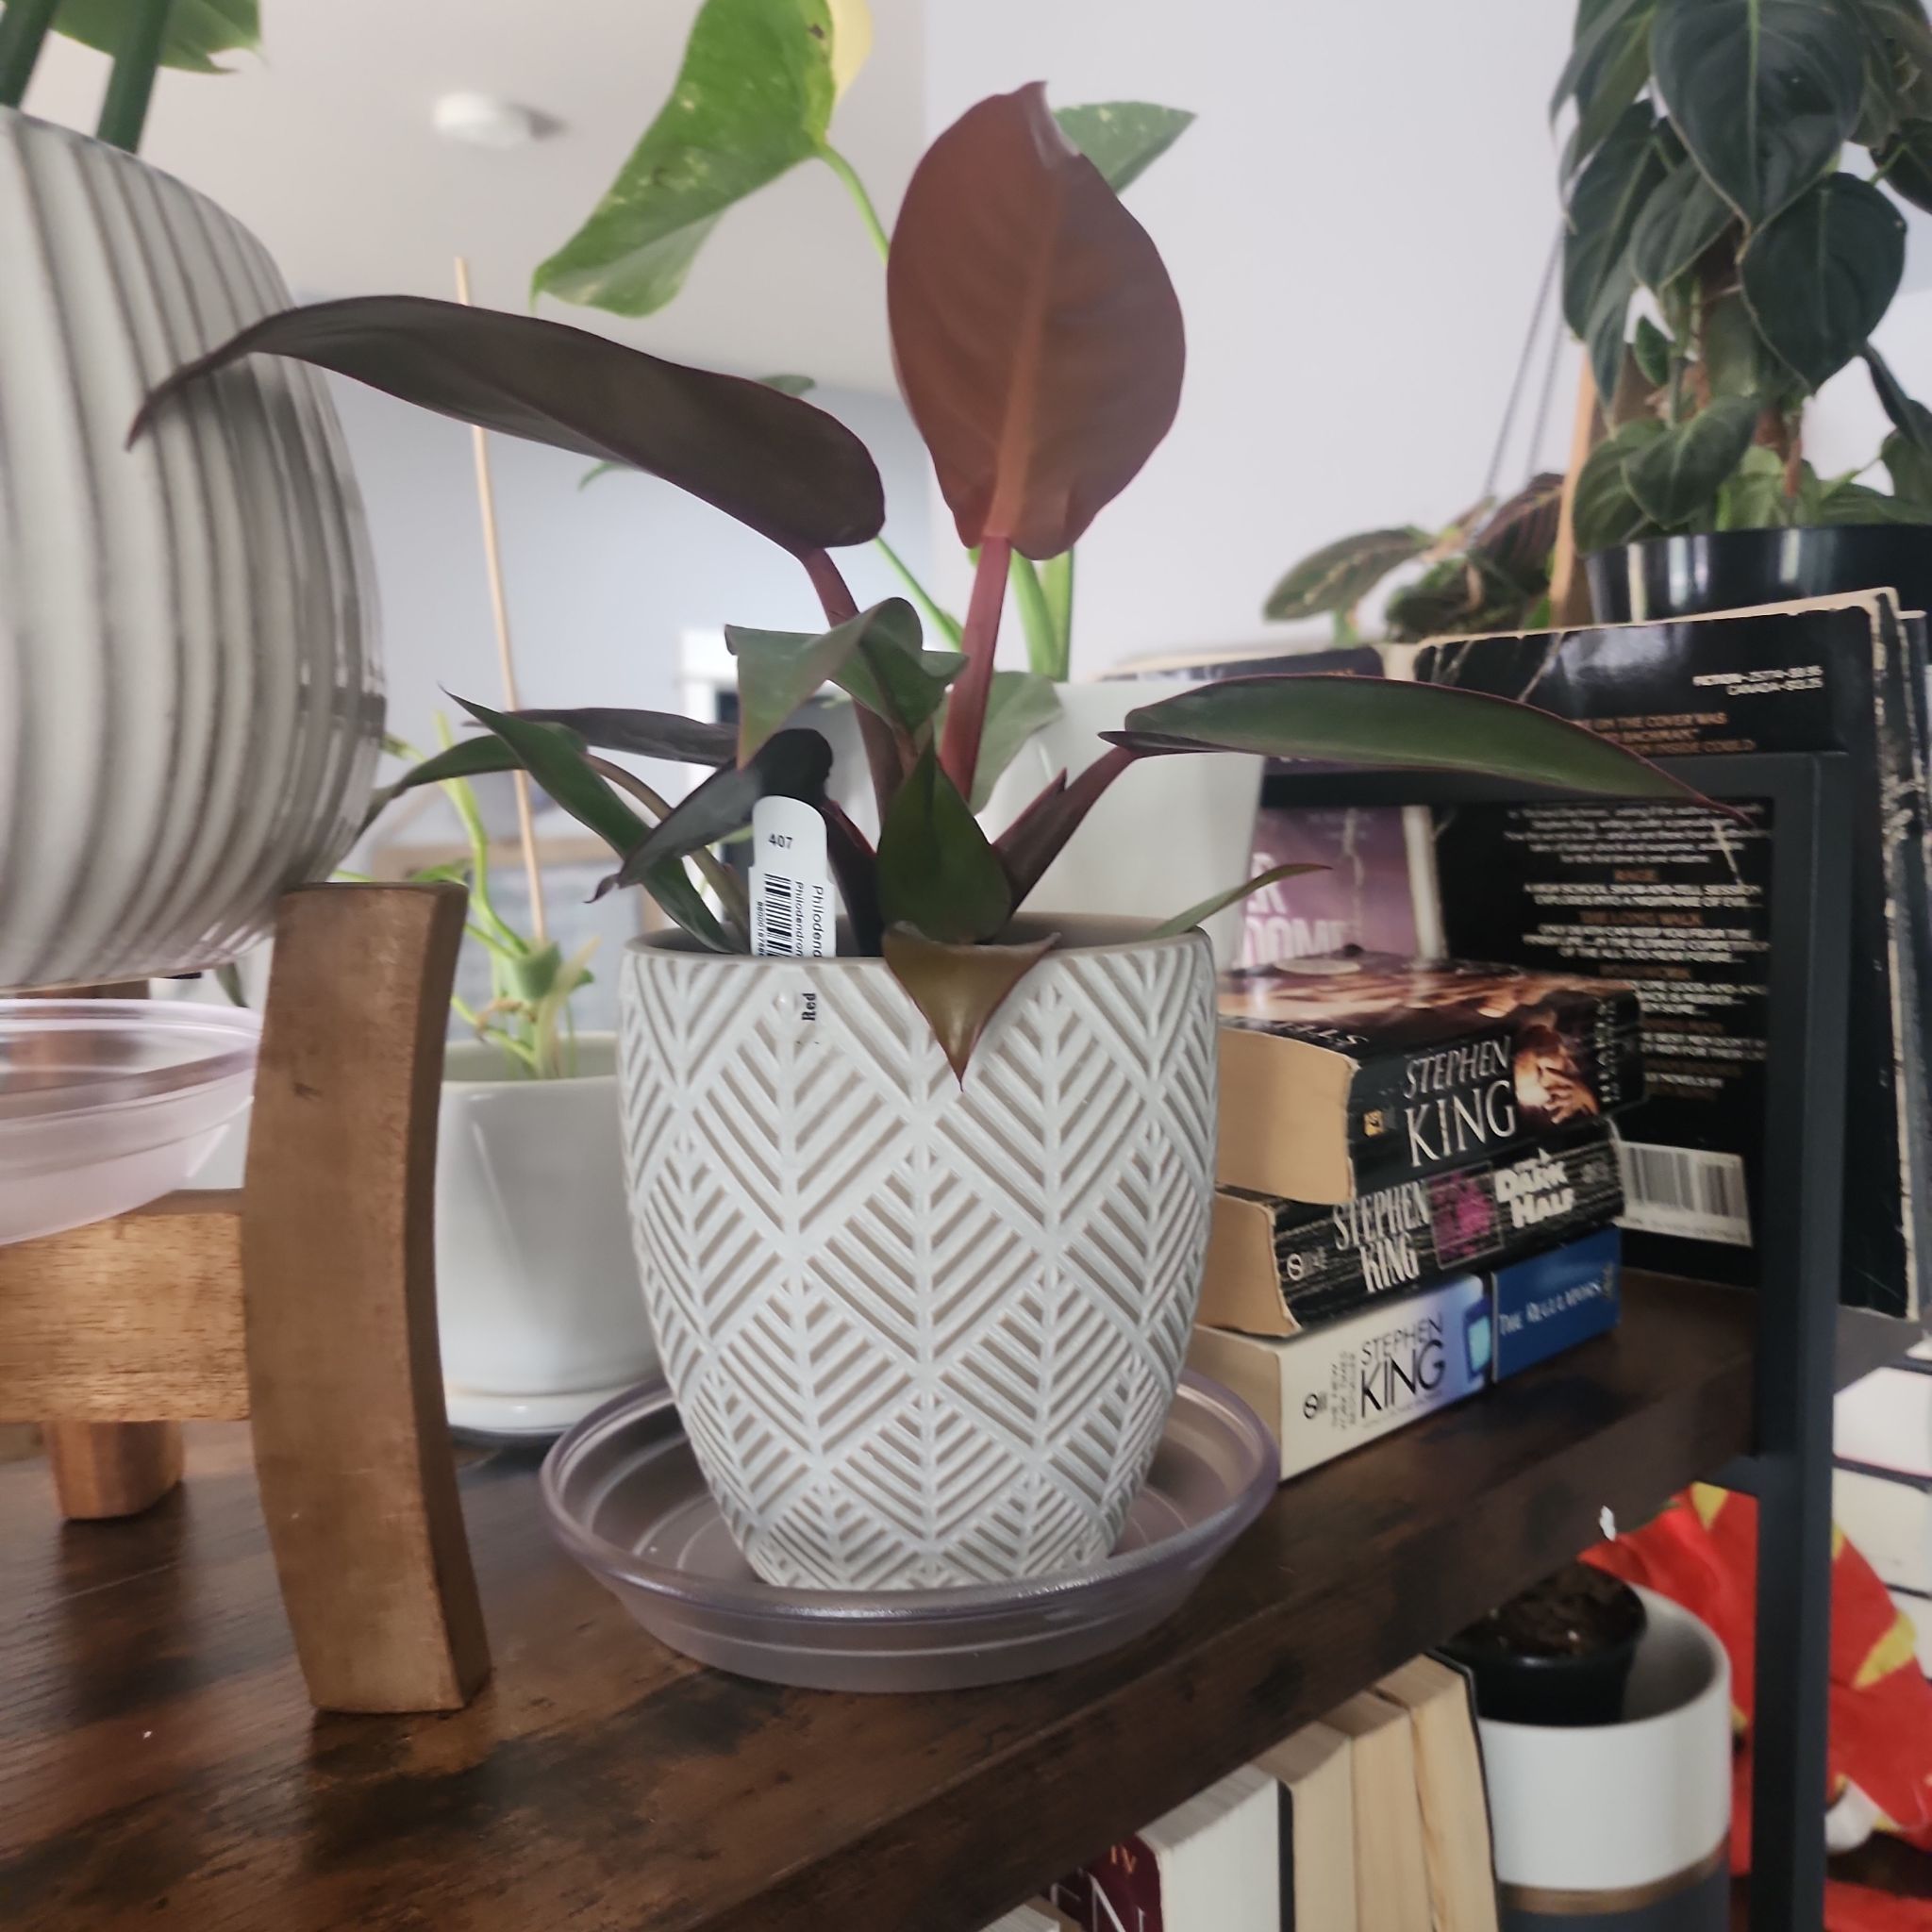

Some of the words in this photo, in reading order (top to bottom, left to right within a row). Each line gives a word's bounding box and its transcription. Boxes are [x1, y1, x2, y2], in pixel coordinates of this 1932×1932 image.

[768, 833, 793, 849] 407
[802, 992, 817, 1021] Red
[1404, 1035, 1511, 1099] STEPHEN
[1405, 1080, 1516, 1167] KING
[1494, 1160, 1569, 1203] DARK
[1510, 1187, 1574, 1228] HALF
[1333, 1180, 1431, 1251] STEPHEN
[1359, 1232, 1420, 1293] KING
[1360, 1311, 1443, 1366] STEPHEN
[1361, 1339, 1446, 1419] KING
